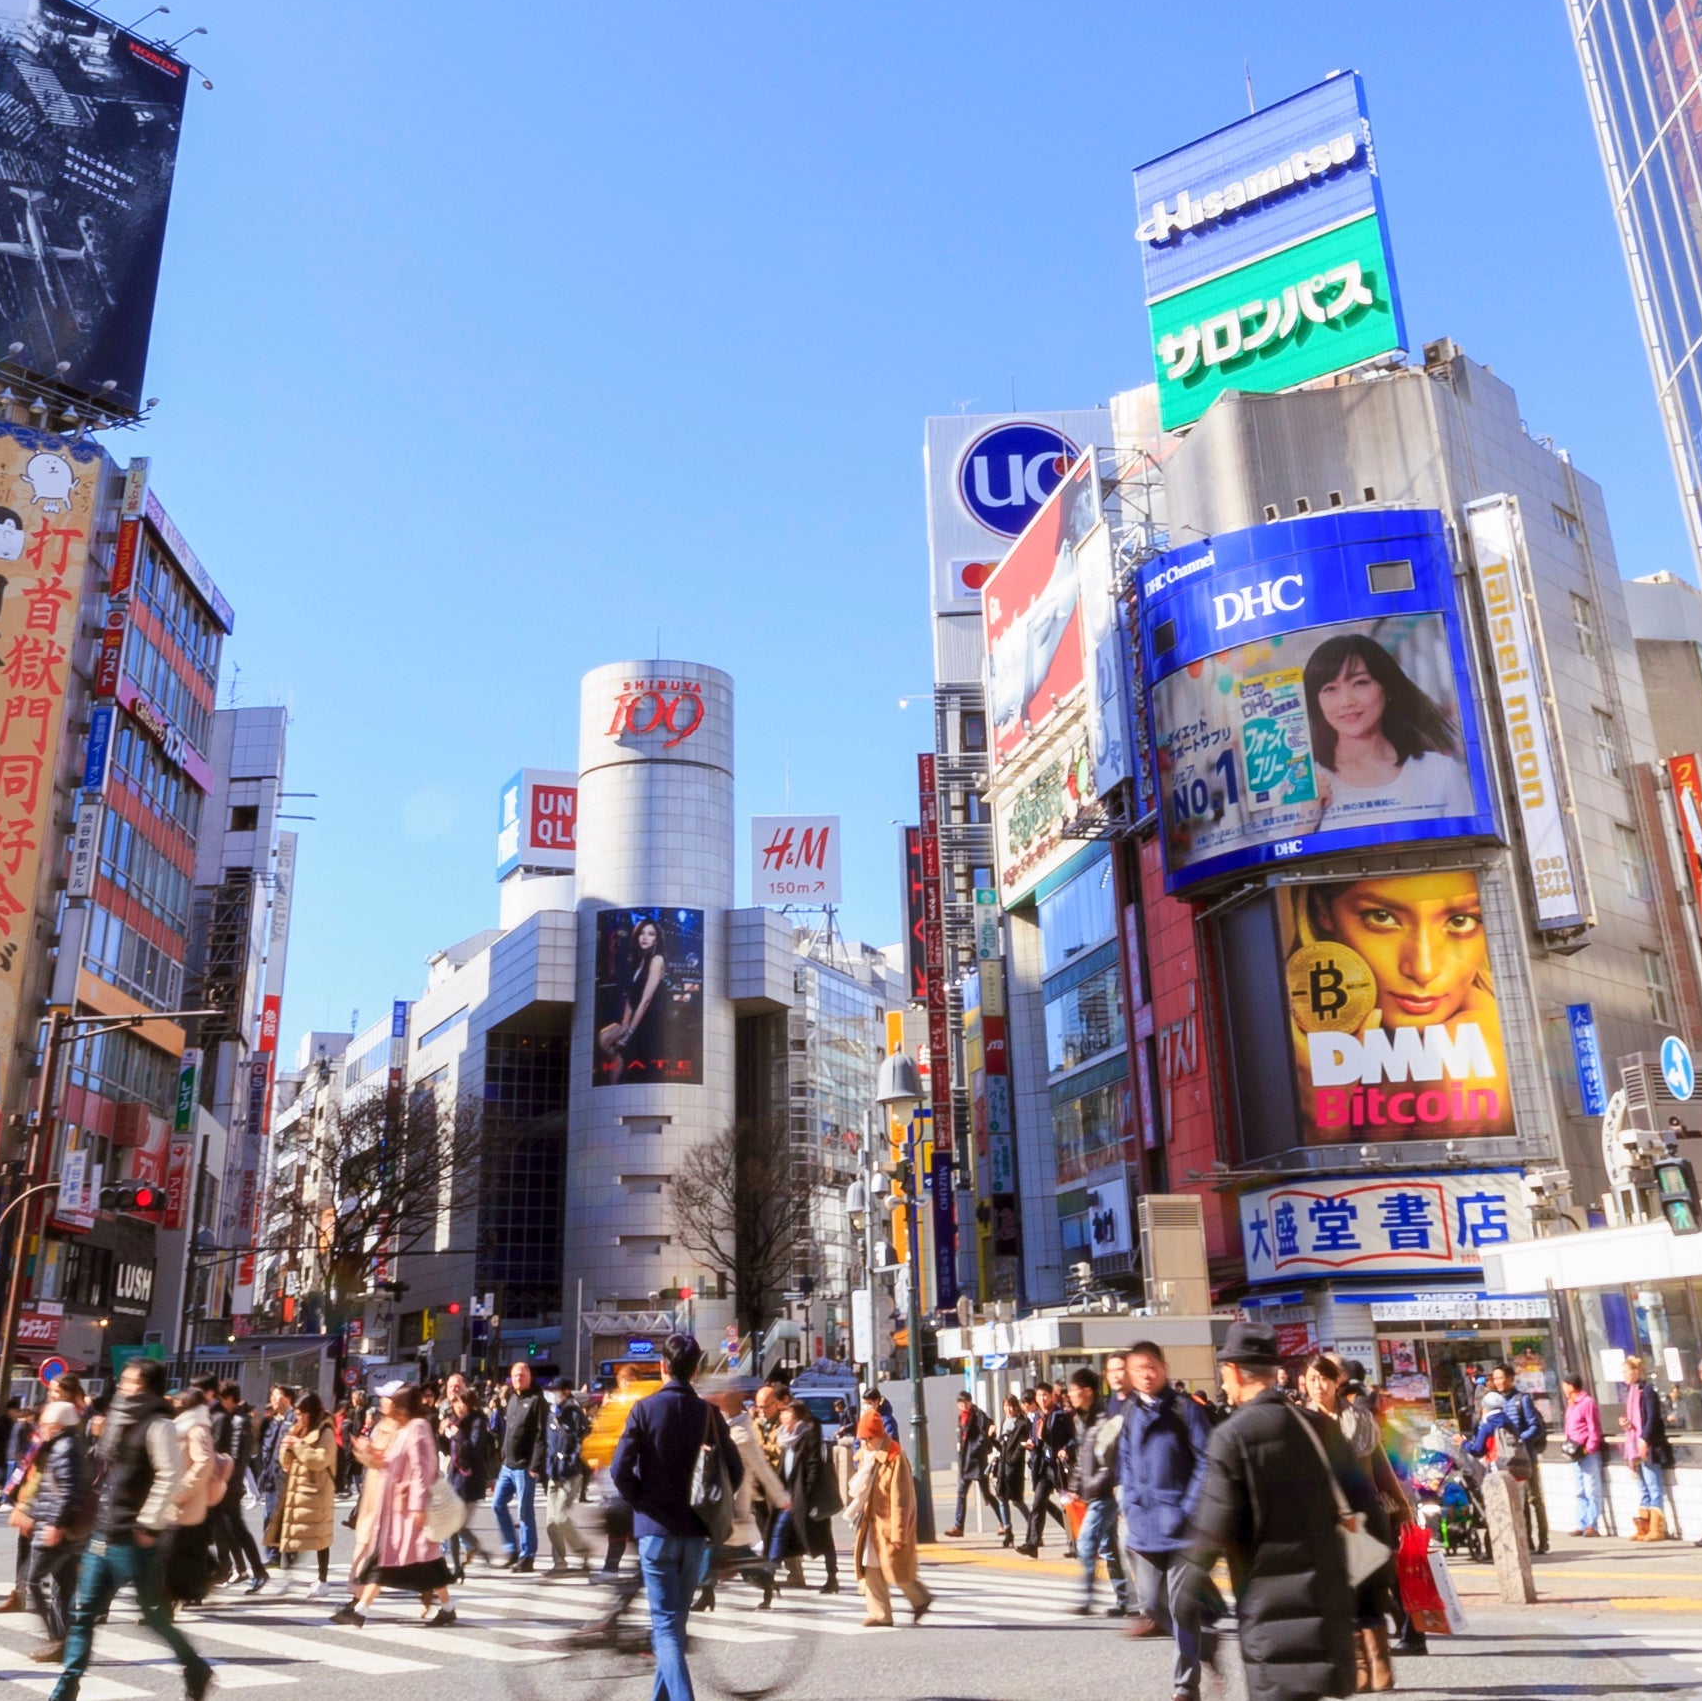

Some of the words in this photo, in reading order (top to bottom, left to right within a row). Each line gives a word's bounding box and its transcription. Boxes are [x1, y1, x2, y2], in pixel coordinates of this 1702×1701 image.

[127, 40, 182, 77] HONDA
[1134, 132, 1357, 242] Hisamitsu
[1158, 260, 1373, 381] サロンパス
[1145, 574, 1166, 597] DHC
[1166, 550, 1216, 586] Channel
[1214, 574, 1305, 631] DHC
[101, 648, 119, 688] ガスト
[622, 679, 703, 693] SHIBUYA
[604, 690, 705, 749] 109
[1241, 693, 1274, 718] DHC
[1507, 694, 1545, 810] neon
[71, 811, 93, 890] 渋谷駅前ビル
[762, 825, 831, 872] H&M
[1274, 839, 1303, 857] DHC
[768, 880, 810, 895] 150m
[602, 1059, 692, 1071] KATE
[1307, 1022, 1497, 1086] DMM
[1315, 1082, 1500, 1129] Bitcoin
[166, 1176, 181, 1212] アコム
[938, 1164, 948, 1211] MIZUHO
[1249, 1191, 1510, 1263] 大盛堂書店
[115, 1262, 153, 1302] LUSH
